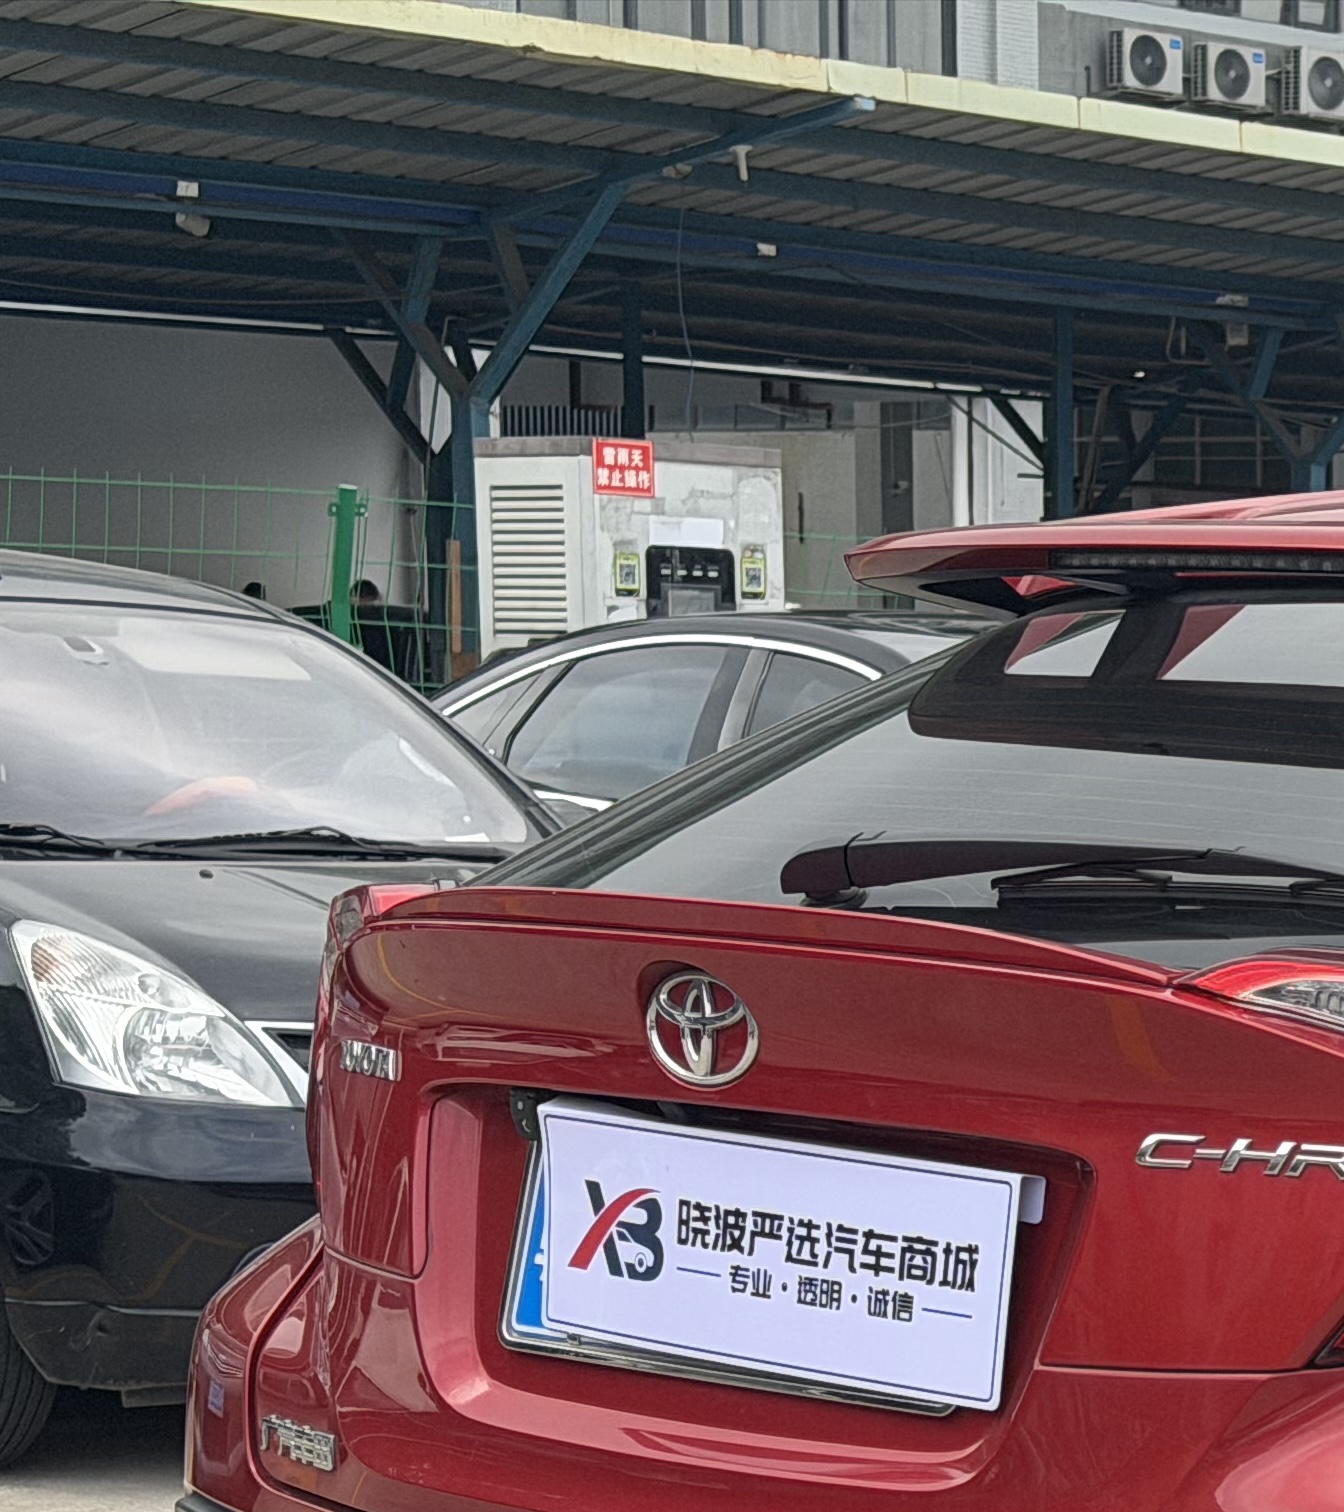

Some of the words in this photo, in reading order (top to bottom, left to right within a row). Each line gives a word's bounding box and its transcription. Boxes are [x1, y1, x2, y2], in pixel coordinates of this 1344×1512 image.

[675, 1196, 981, 1294] 晓波严选汽车商城
[260, 1414, 336, 1472] 广汽丰田
